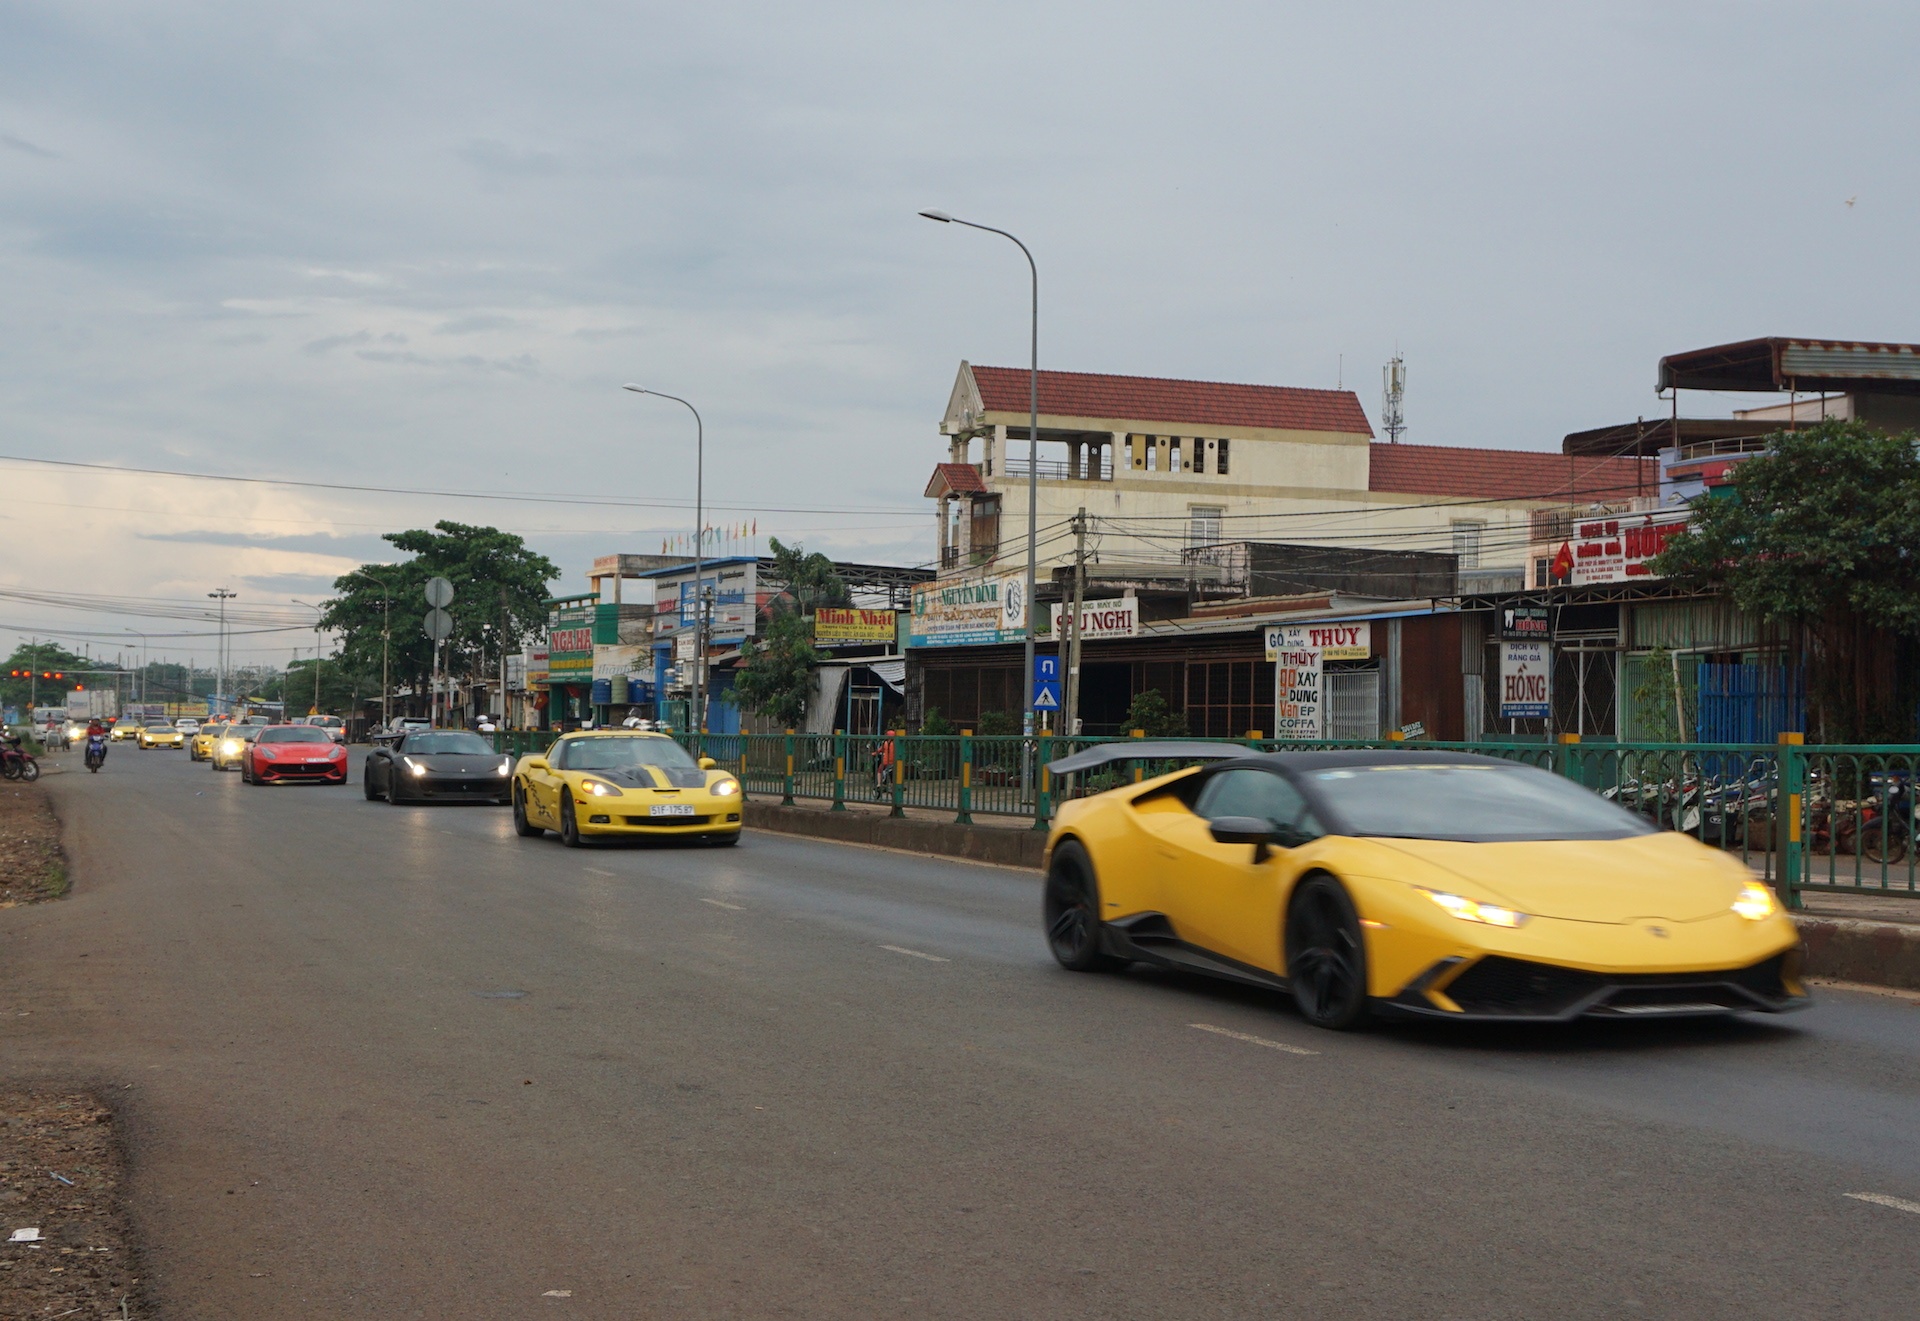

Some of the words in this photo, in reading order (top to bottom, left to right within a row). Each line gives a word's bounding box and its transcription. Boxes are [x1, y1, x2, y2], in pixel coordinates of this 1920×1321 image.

[818, 607, 855, 624] Minh
[859, 609, 894, 630] Nhật
[1091, 610, 1133, 635] NGHỊ
[551, 629, 574, 653] NGA
[1505, 663, 1546, 702] HỒNG
[1280, 719, 1315, 728] COFFA
